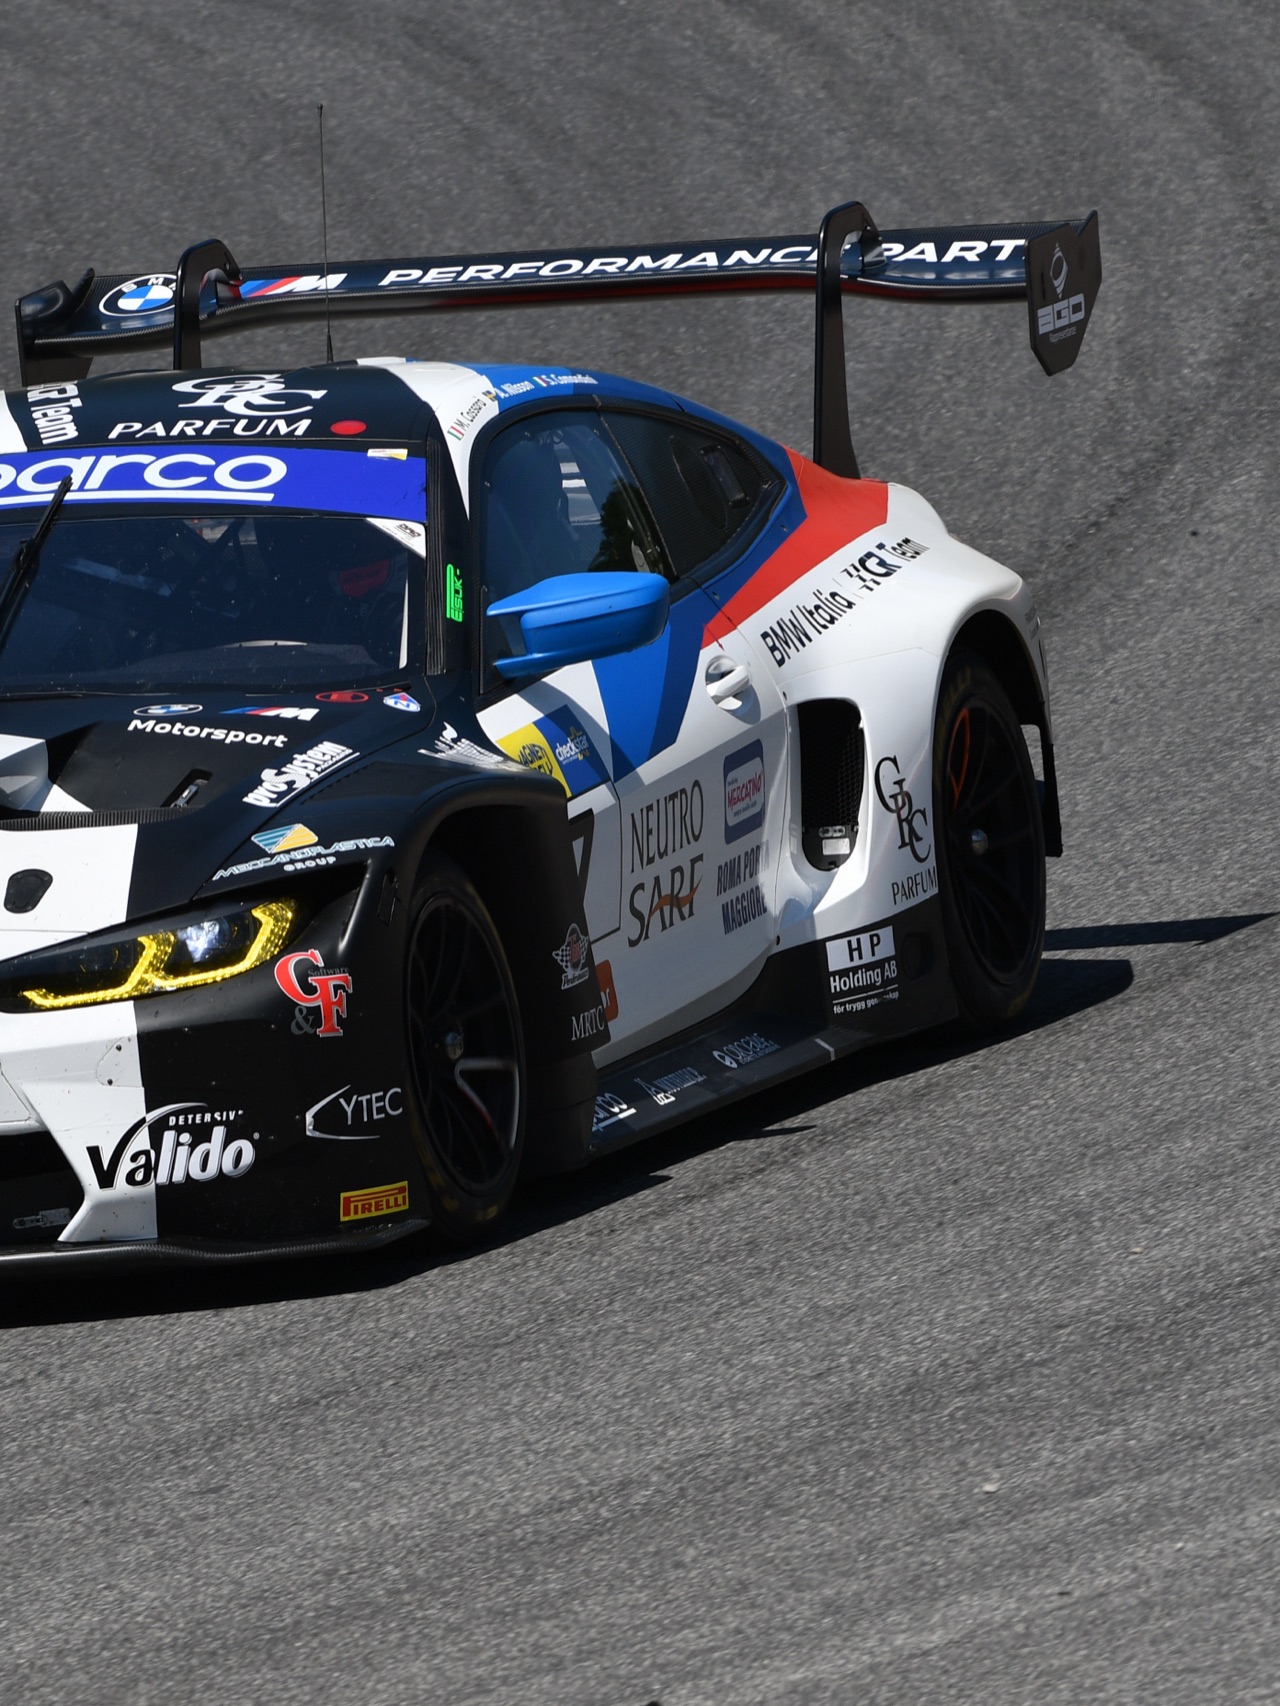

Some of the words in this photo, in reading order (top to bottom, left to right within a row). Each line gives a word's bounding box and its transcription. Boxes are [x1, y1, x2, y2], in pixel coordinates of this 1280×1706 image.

[880, 239, 1026, 263] PART
[30, 397, 83, 446] Team
[107, 418, 313, 439] PARFUM
[760, 609, 813, 668] BMW
[796, 588, 857, 636] Italia
[875, 536, 931, 562] Team
[126, 718, 288, 748] Motorsport
[630, 779, 704, 875] NEUTRO
[283, 855, 337, 872] GROUP
[716, 854, 742, 897] ROMA
[743, 839, 770, 882] PORTA
[891, 865, 938, 906] PARFUM
[721, 882, 768, 936] MAGGIORE
[307, 966, 350, 977] Software
[829, 967, 883, 994] Holding
[883, 960, 898, 980] AB
[570, 1004, 605, 1042] MRTC
[845, 1000, 866, 1013] trygg
[85, 1103, 257, 1191] Valido
[341, 1182, 408, 1218] PIRELLI
